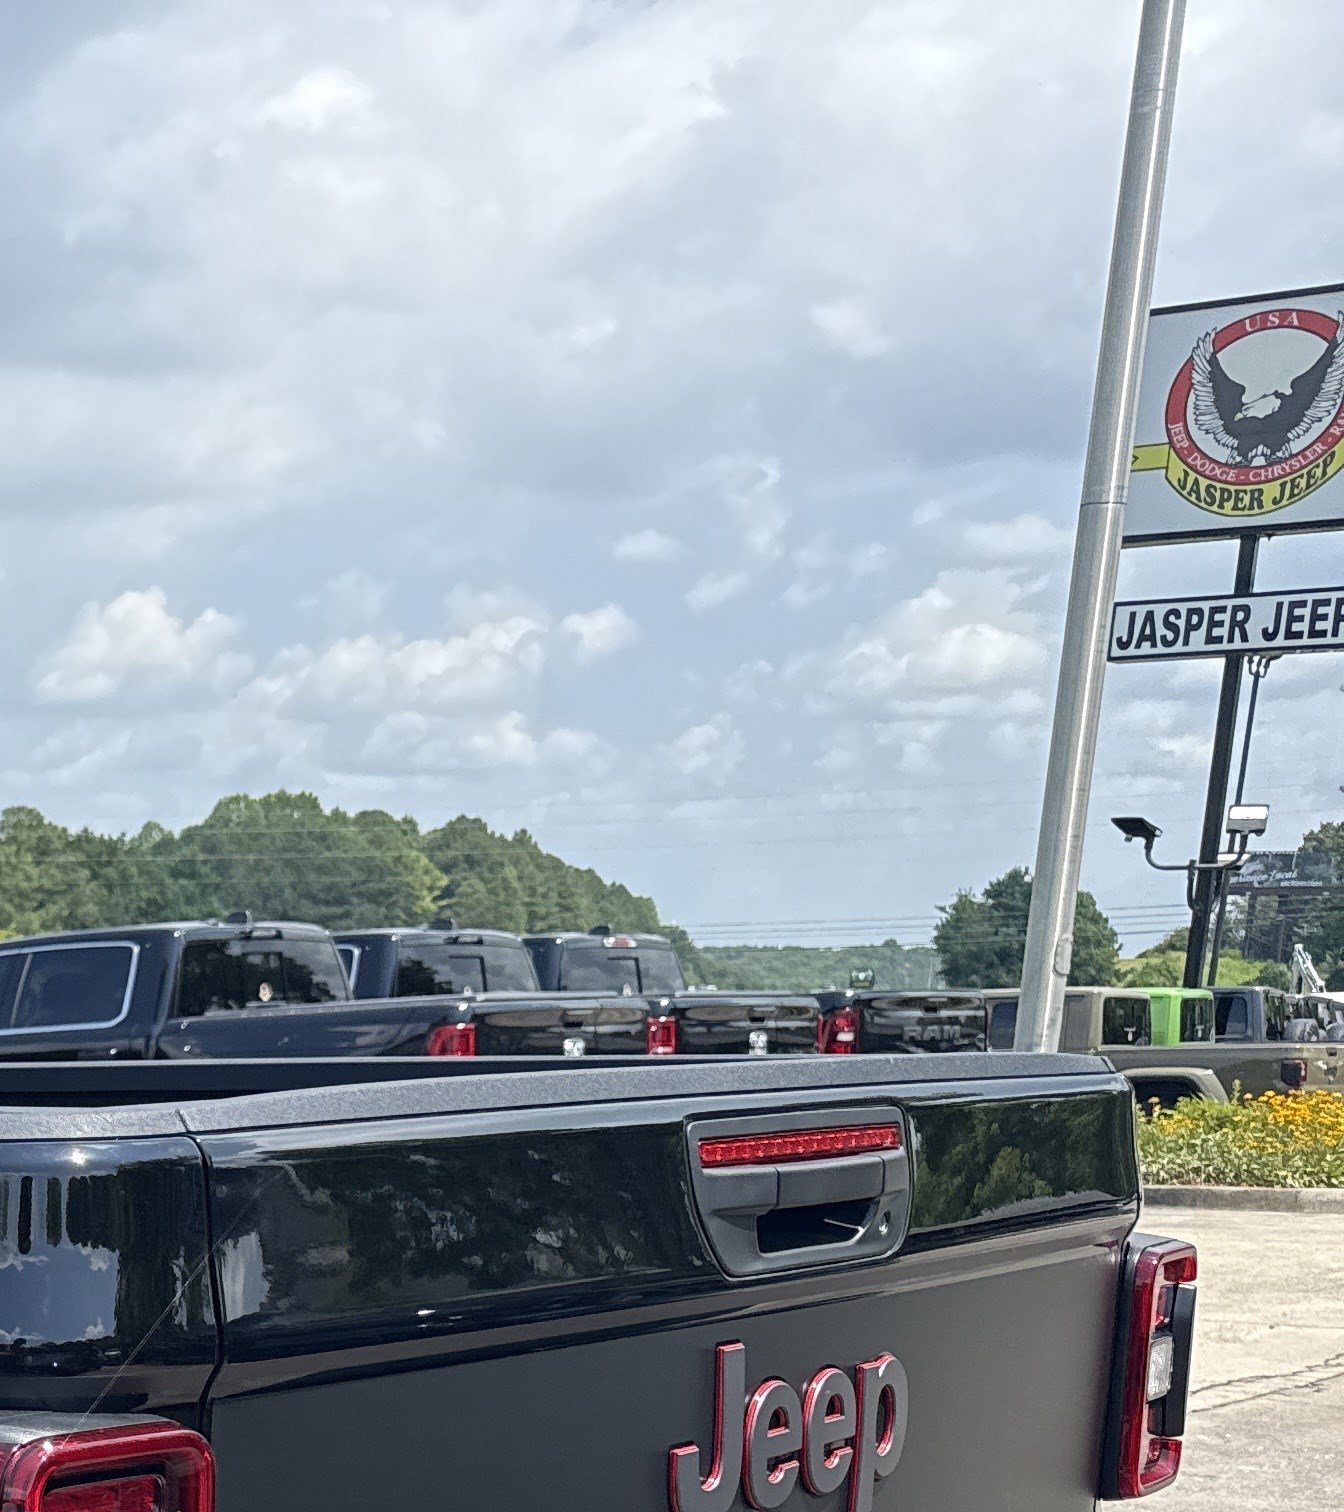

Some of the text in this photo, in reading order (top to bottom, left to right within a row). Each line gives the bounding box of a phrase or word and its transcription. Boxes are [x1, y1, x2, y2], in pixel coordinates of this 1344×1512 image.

[1244, 311, 1300, 332] USA
[1168, 421, 1190, 449] JEEP
[1187, 451, 1239, 481] DODGE
[1248, 441, 1329, 482] CHRYSLER
[1177, 449, 1337, 512] JASPER JEEP
[1115, 603, 1252, 651] JASPER
